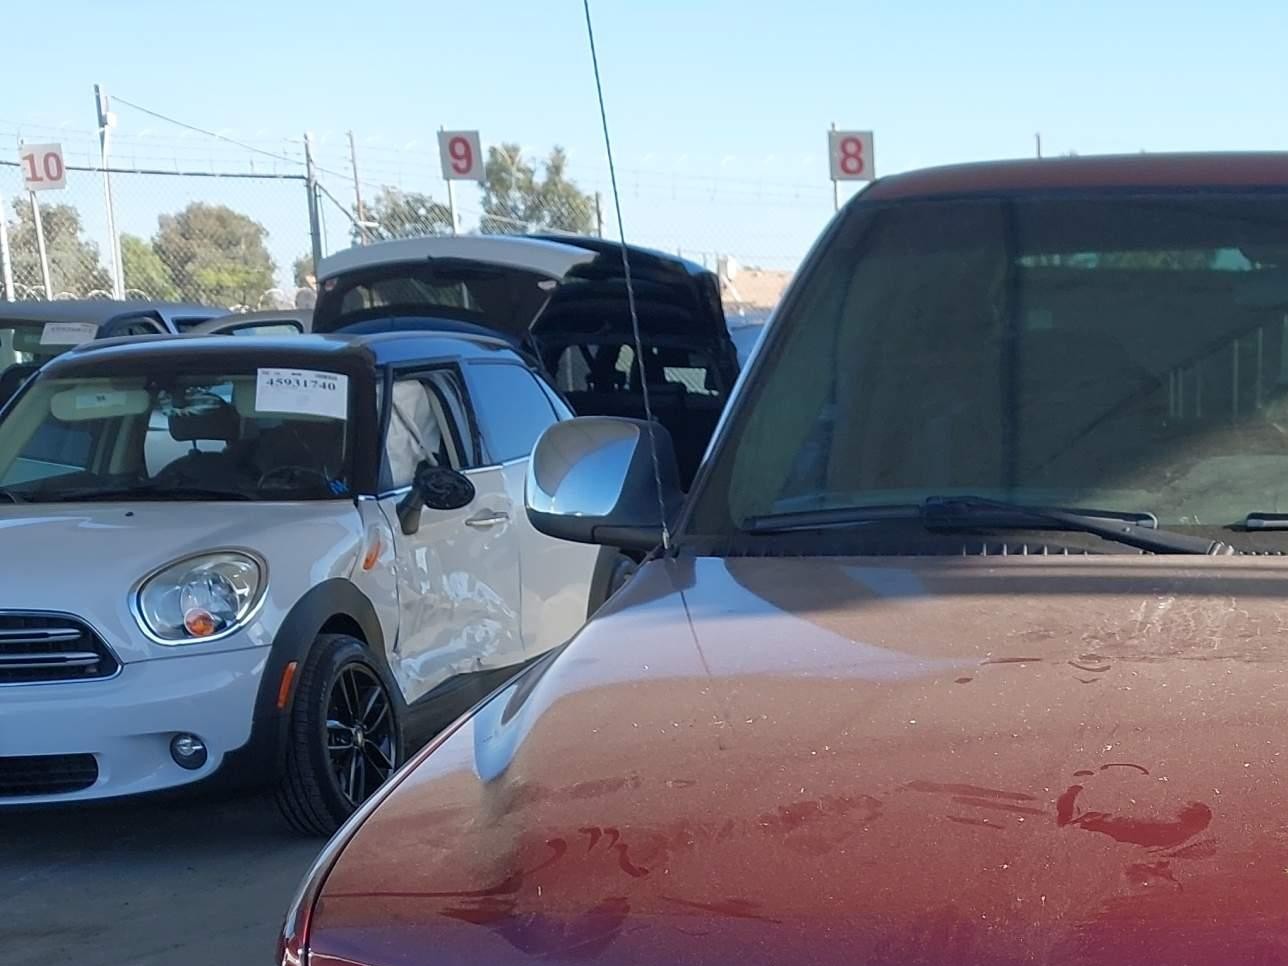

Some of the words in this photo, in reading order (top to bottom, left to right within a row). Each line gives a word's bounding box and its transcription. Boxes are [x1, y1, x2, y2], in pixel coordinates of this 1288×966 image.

[22, 152, 63, 182] 10
[449, 136, 472, 175] 9
[840, 137, 864, 175] 8
